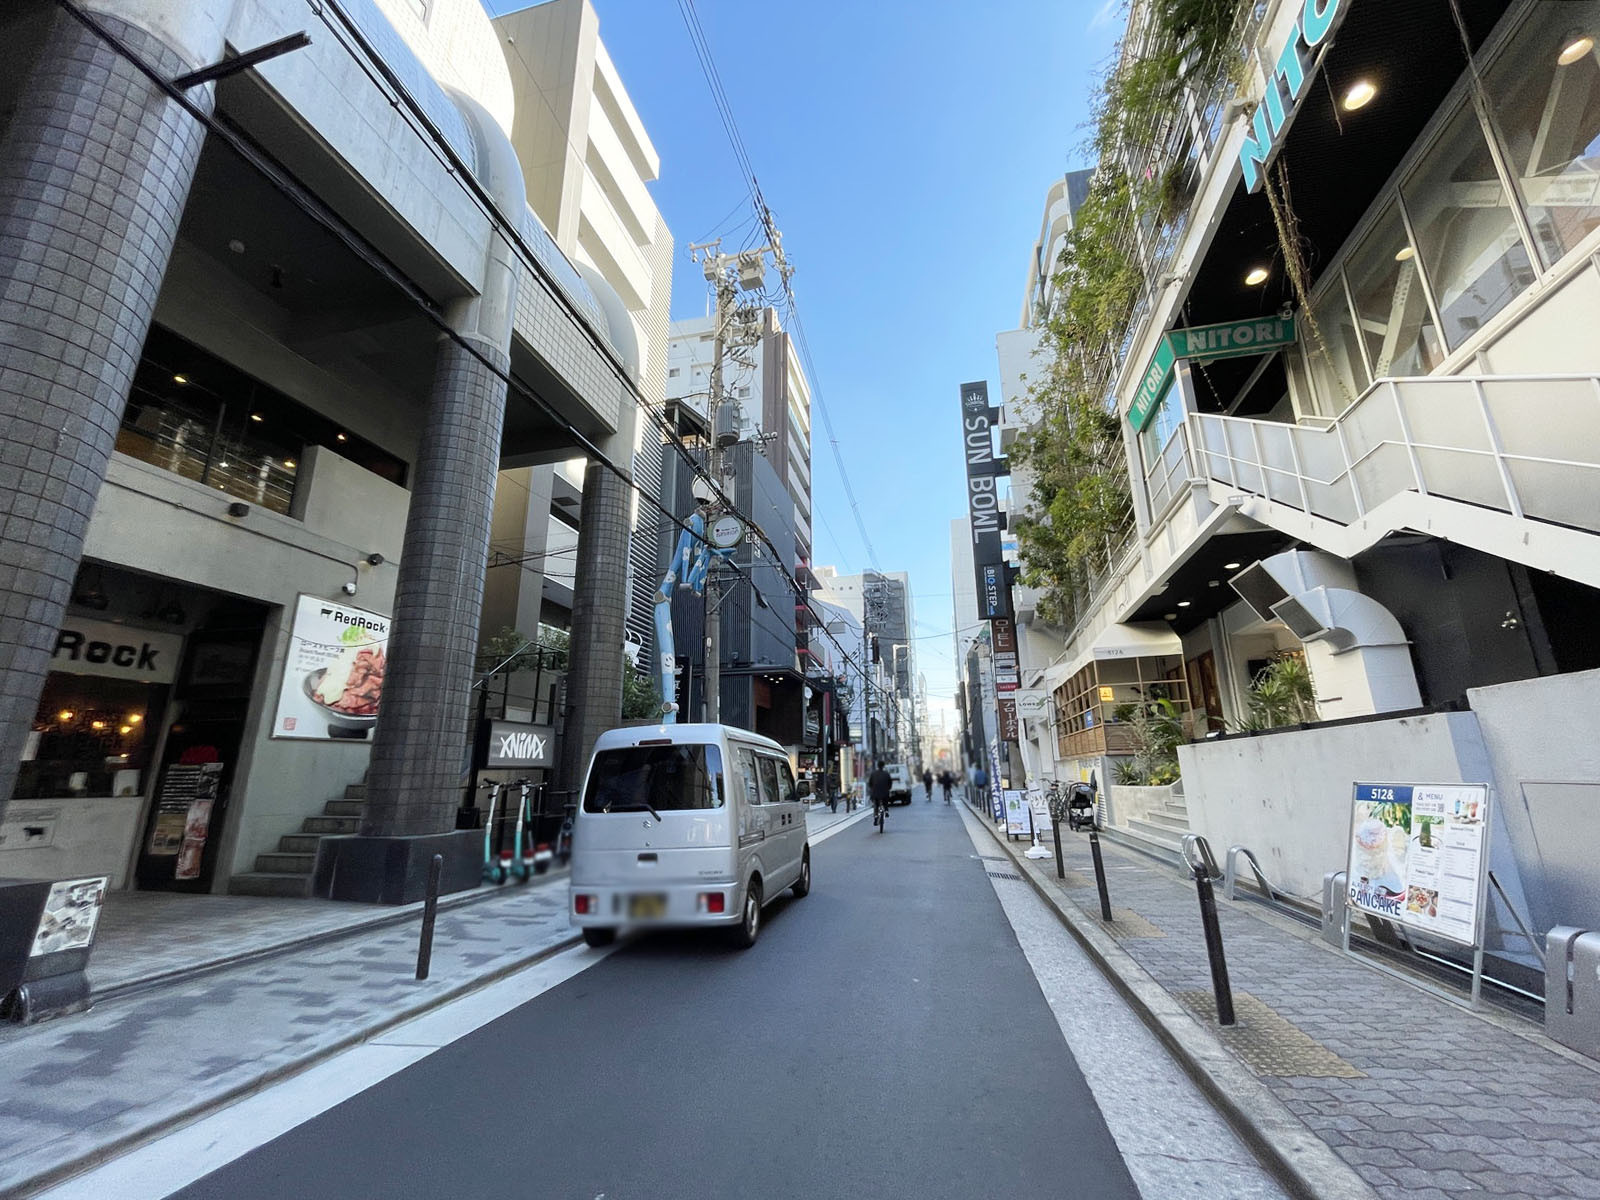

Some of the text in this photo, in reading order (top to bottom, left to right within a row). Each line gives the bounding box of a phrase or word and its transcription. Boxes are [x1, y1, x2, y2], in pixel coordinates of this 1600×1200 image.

[1186, 321, 1284, 351] NITORI
[1136, 362, 1164, 415] NITORI
[965, 416, 998, 544] SUN BOWL
[334, 611, 386, 633] RedRock
[1371, 788, 1394, 800] 512&
[1350, 888, 1401, 916] PANCAKE
